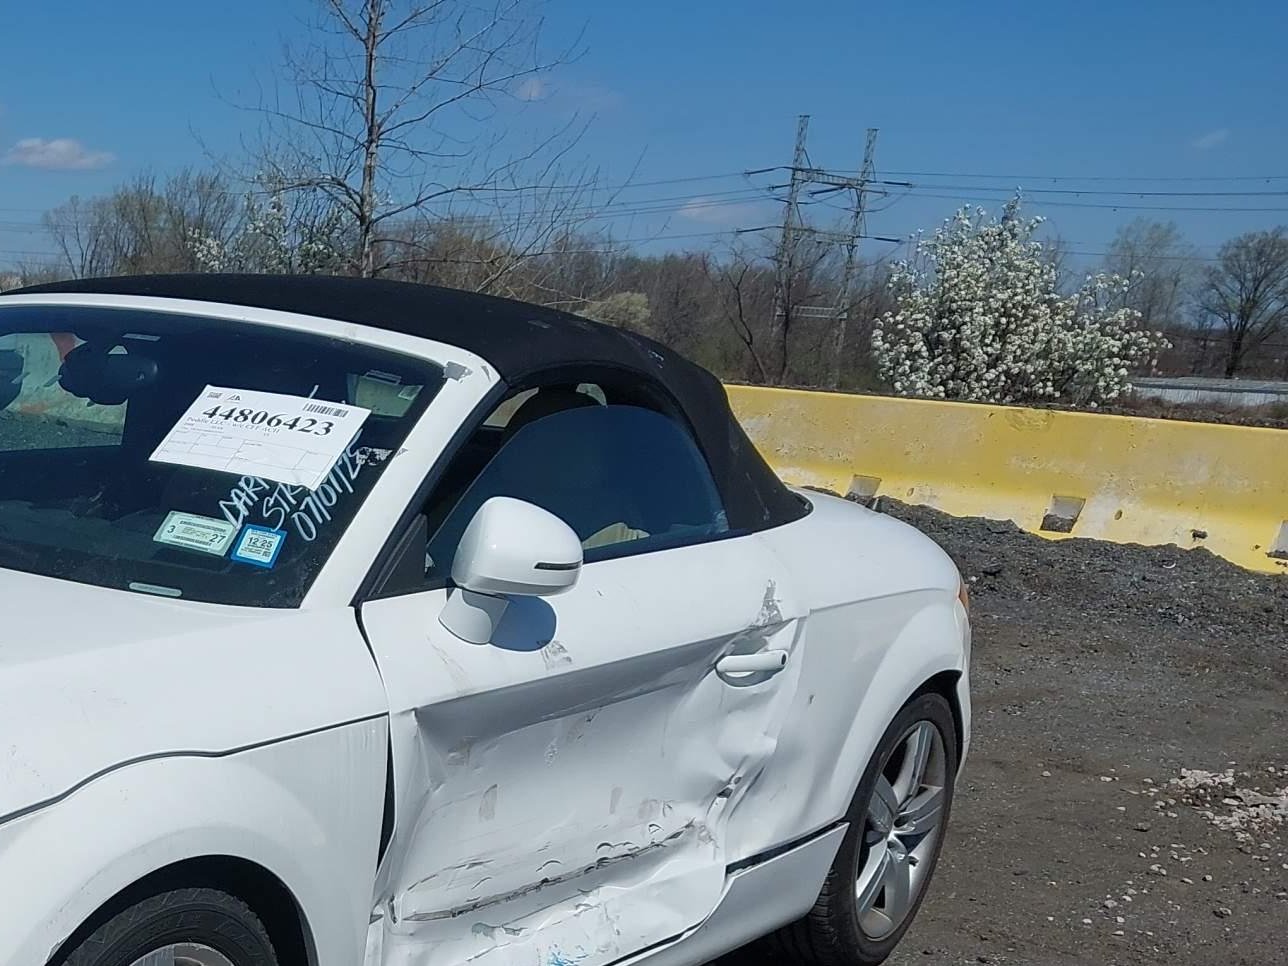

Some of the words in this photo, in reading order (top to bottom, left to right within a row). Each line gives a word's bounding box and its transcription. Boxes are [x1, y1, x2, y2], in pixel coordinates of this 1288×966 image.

[203, 405, 334, 436] 44806423
[167, 524, 176, 534] 3
[209, 533, 226, 545] 27
